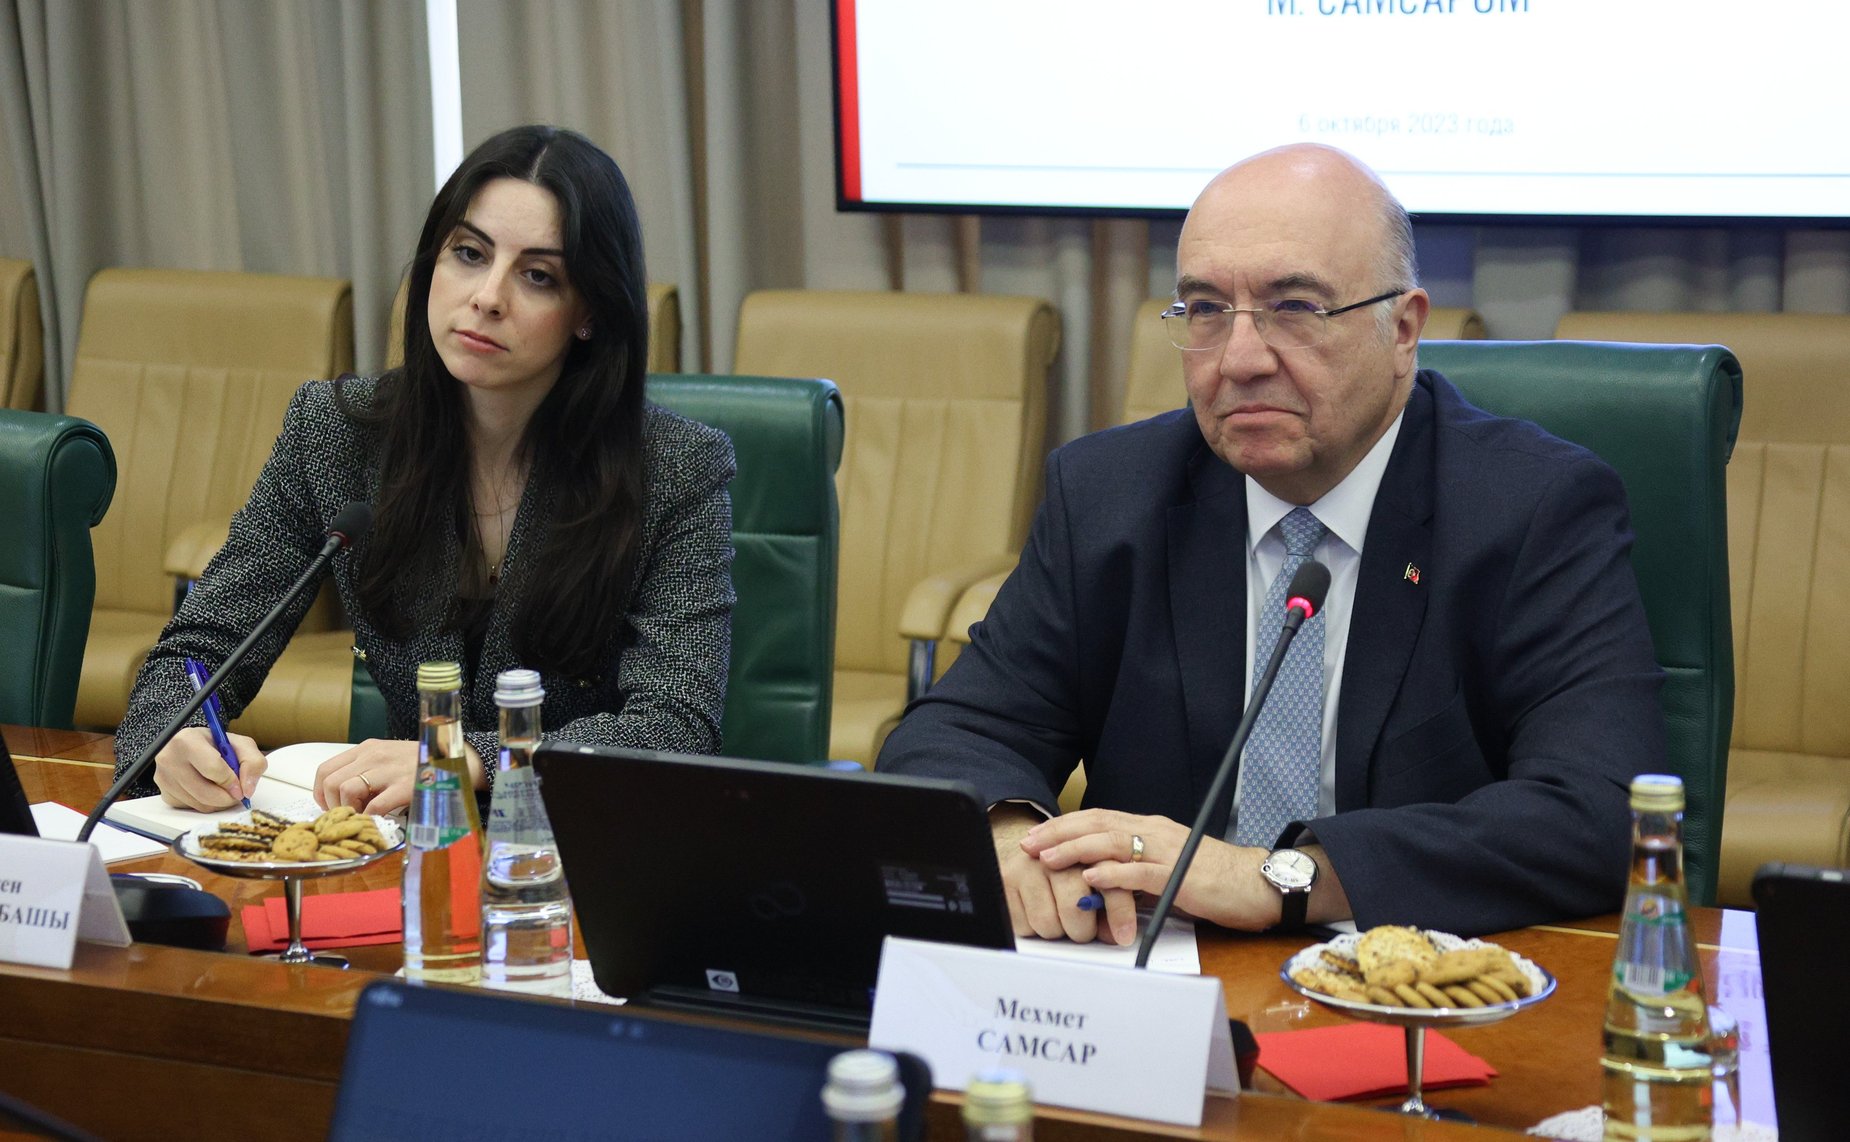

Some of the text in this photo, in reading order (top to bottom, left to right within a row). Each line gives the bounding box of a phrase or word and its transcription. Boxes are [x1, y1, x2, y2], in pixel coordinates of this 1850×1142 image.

[1297, 113, 1515, 136] 6 октября 2023 года
[0, 904, 70, 930] БАШЫ
[995, 997, 1088, 1030] Мехмет
[977, 1029, 1098, 1066] САМСАР
